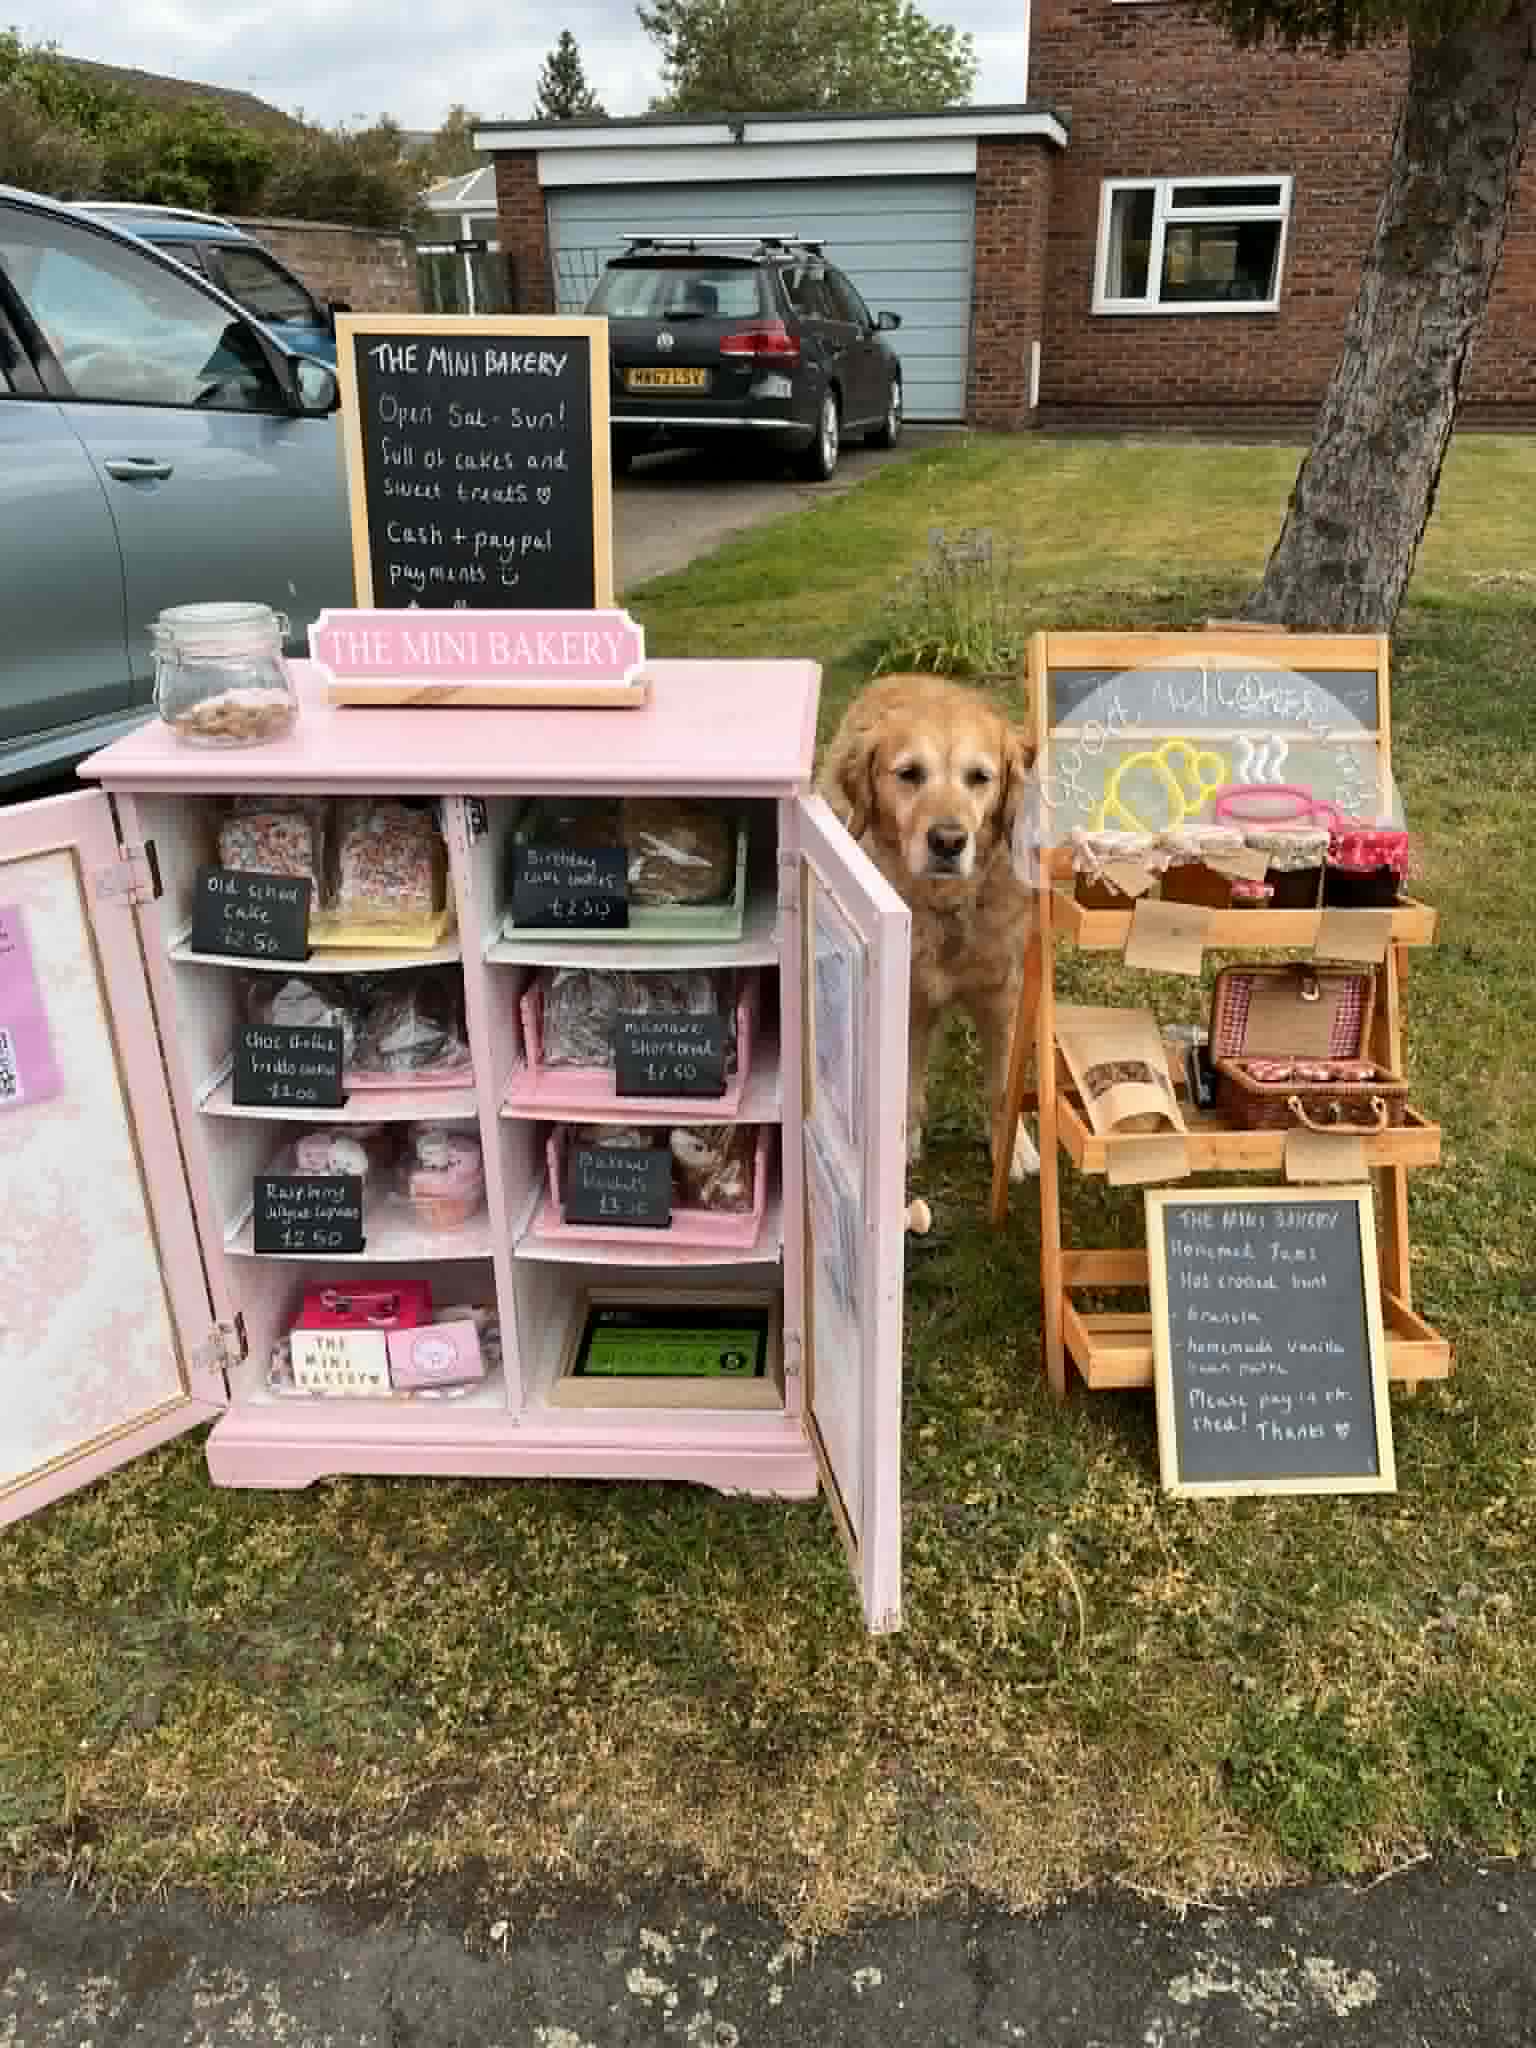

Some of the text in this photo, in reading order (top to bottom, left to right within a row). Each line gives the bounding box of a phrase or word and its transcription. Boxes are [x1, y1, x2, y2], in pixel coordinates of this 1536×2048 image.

[369, 343, 568, 377] THE MINI BAKERY
[378, 395, 433, 428] Open
[455, 449, 513, 472] cakes
[527, 447, 568, 471] and
[457, 480, 528, 503] treats
[390, 564, 487, 591] payments
[328, 631, 625, 665] THE MINI BAKERY
